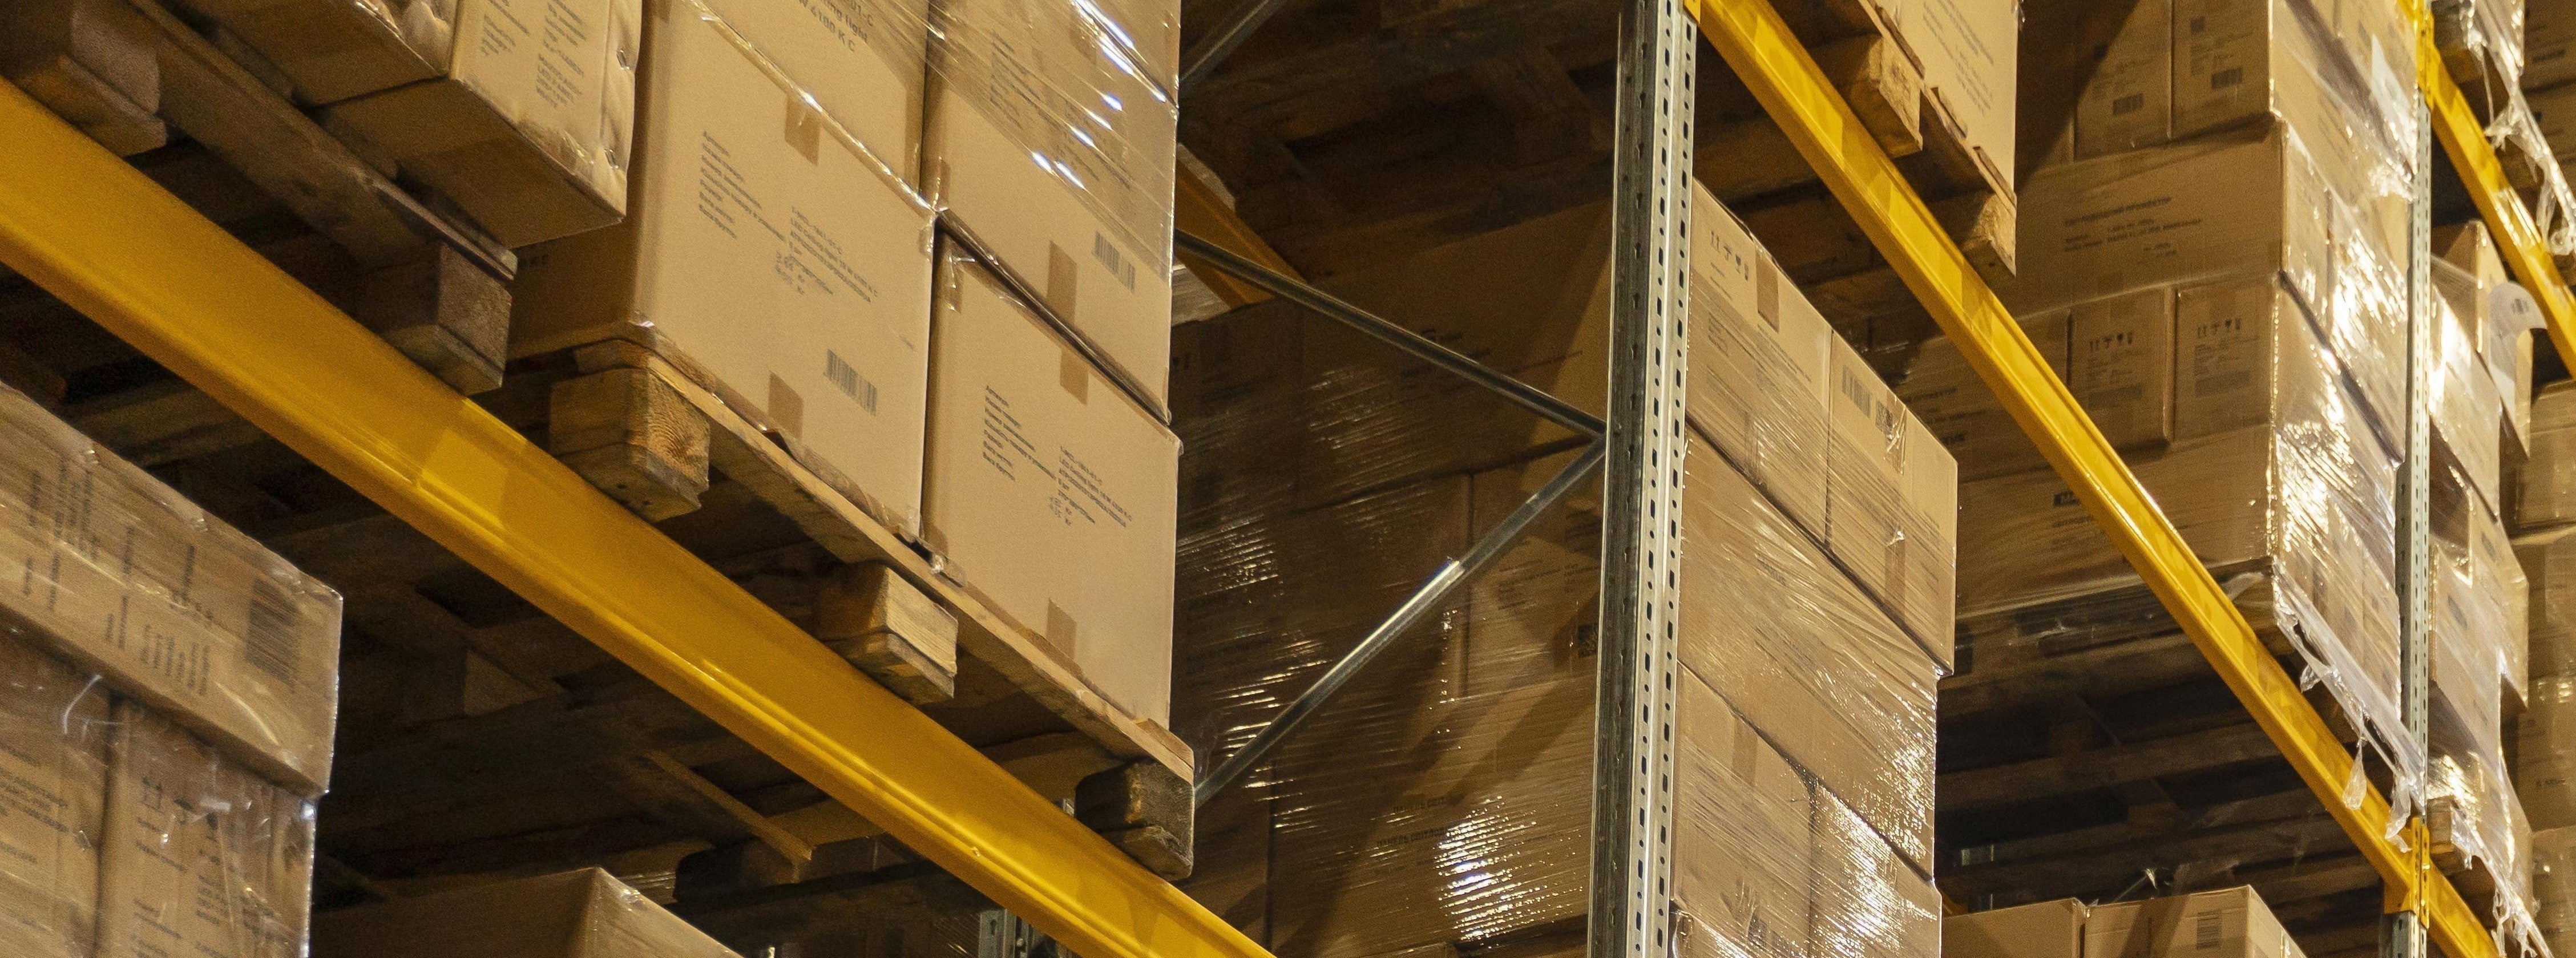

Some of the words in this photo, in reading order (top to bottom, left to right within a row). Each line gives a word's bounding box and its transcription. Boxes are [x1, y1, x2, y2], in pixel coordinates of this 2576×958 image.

[810, 6, 835, 33] 4100
[838, 29, 845, 45] K
[848, 39, 855, 52] C
